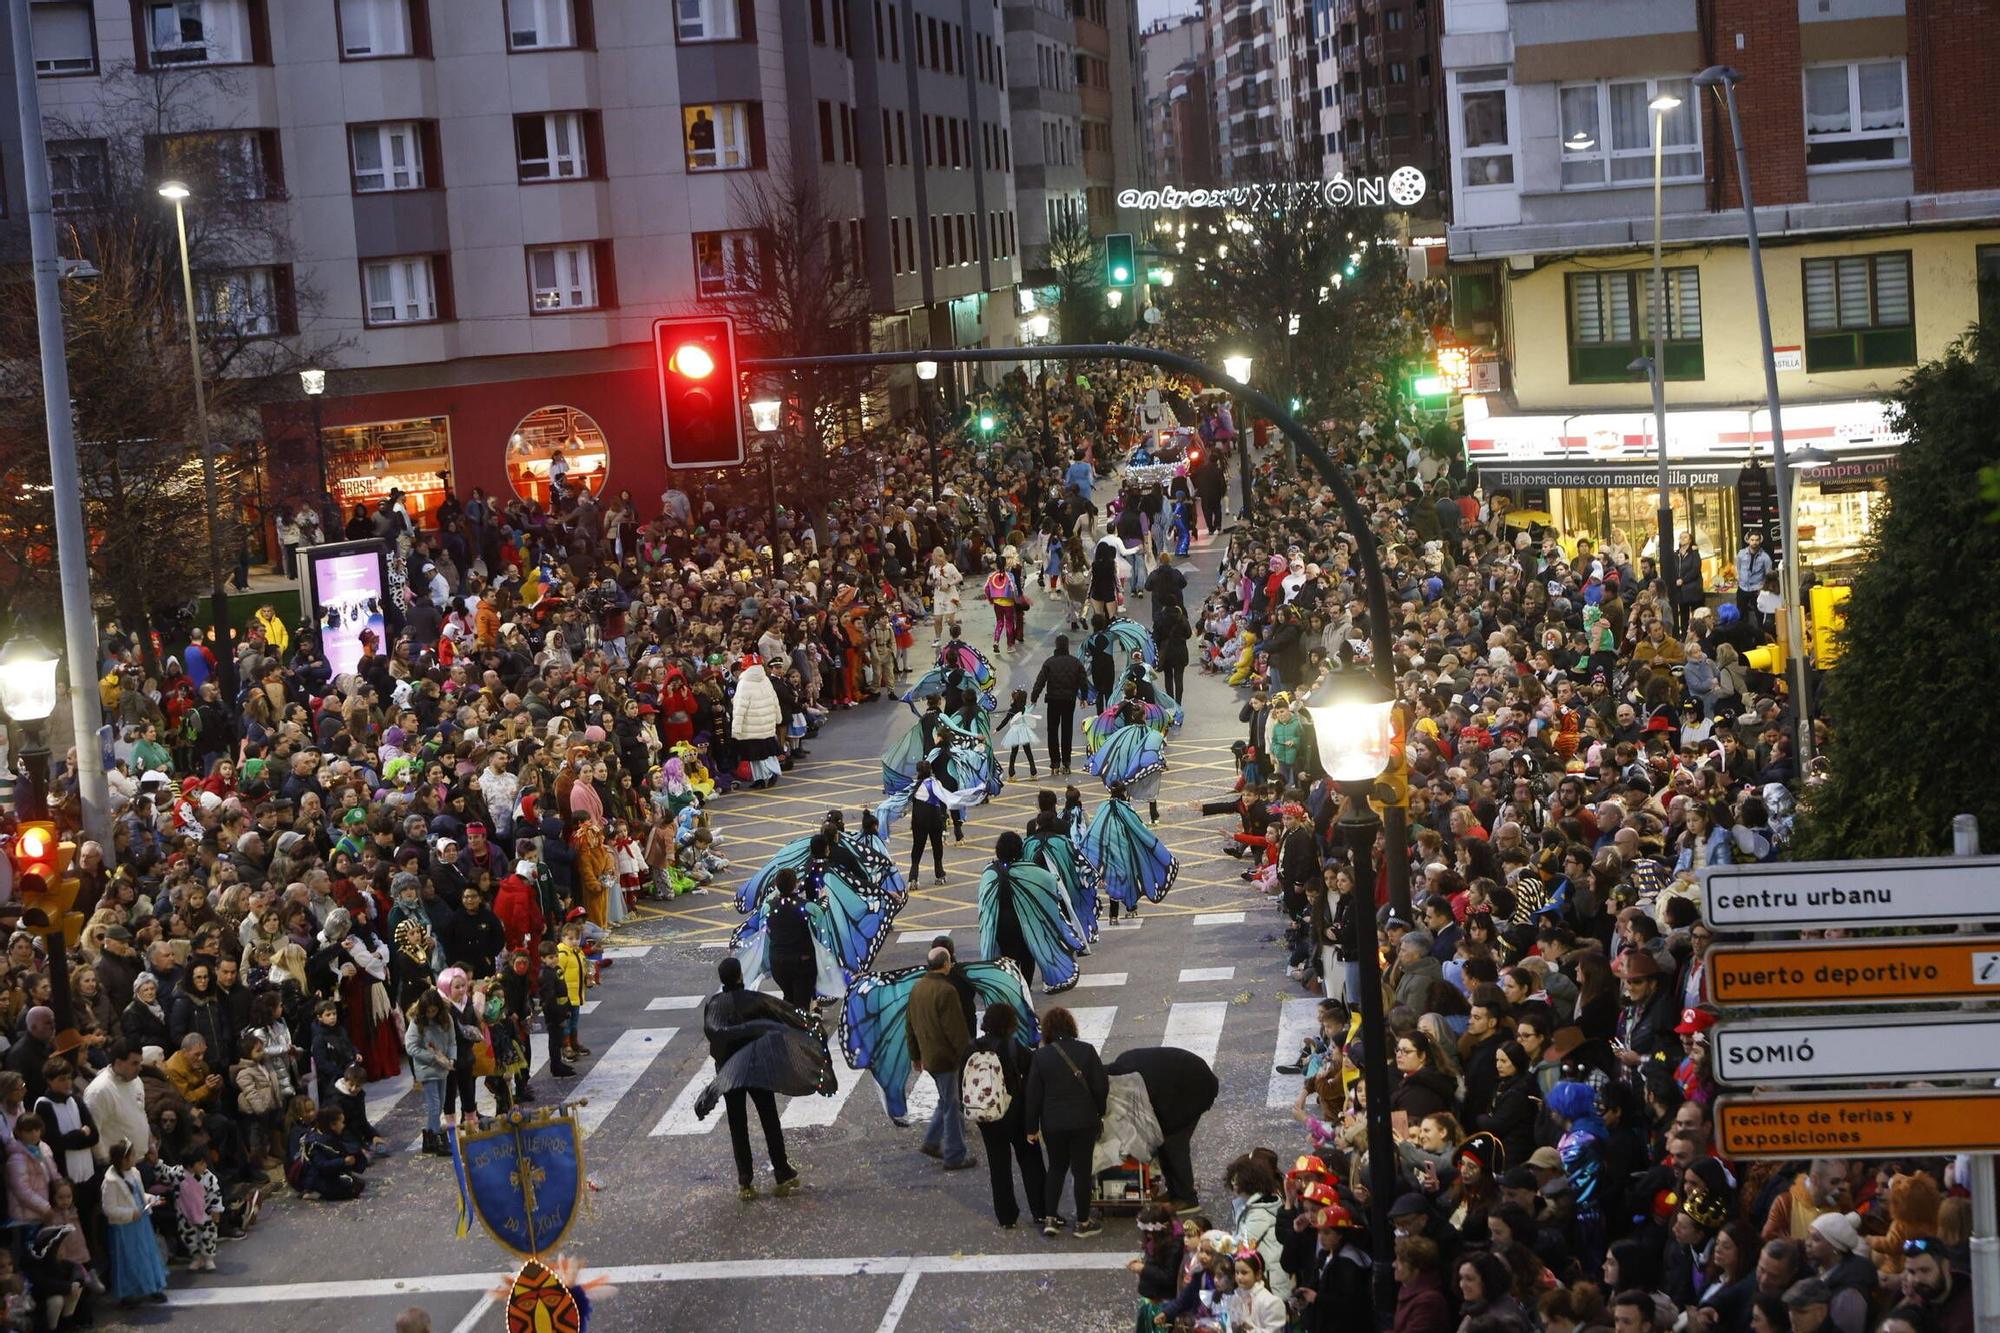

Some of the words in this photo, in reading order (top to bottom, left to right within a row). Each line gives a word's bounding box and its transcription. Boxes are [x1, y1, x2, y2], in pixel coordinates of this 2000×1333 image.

[1501, 472, 1585, 486] Elaboraciones
[1588, 474, 1610, 485] con
[1614, 470, 1687, 487] manteqilla
[1690, 473, 1719, 487] pura
[1801, 463, 1862, 479] Compra
[1717, 890, 1797, 910] centru
[1807, 887, 1892, 907] urbanu
[1722, 967, 1804, 990] puerto
[1814, 962, 1938, 985] deportivo
[1728, 1038, 1814, 1064] SOMIÓ
[1731, 1112, 1800, 1128] recinto
[1808, 1110, 1831, 1124] de
[1839, 1108, 1895, 1123] ferias
[1903, 1109, 1914, 1123] y
[1733, 1130, 1861, 1147] exposiciones
